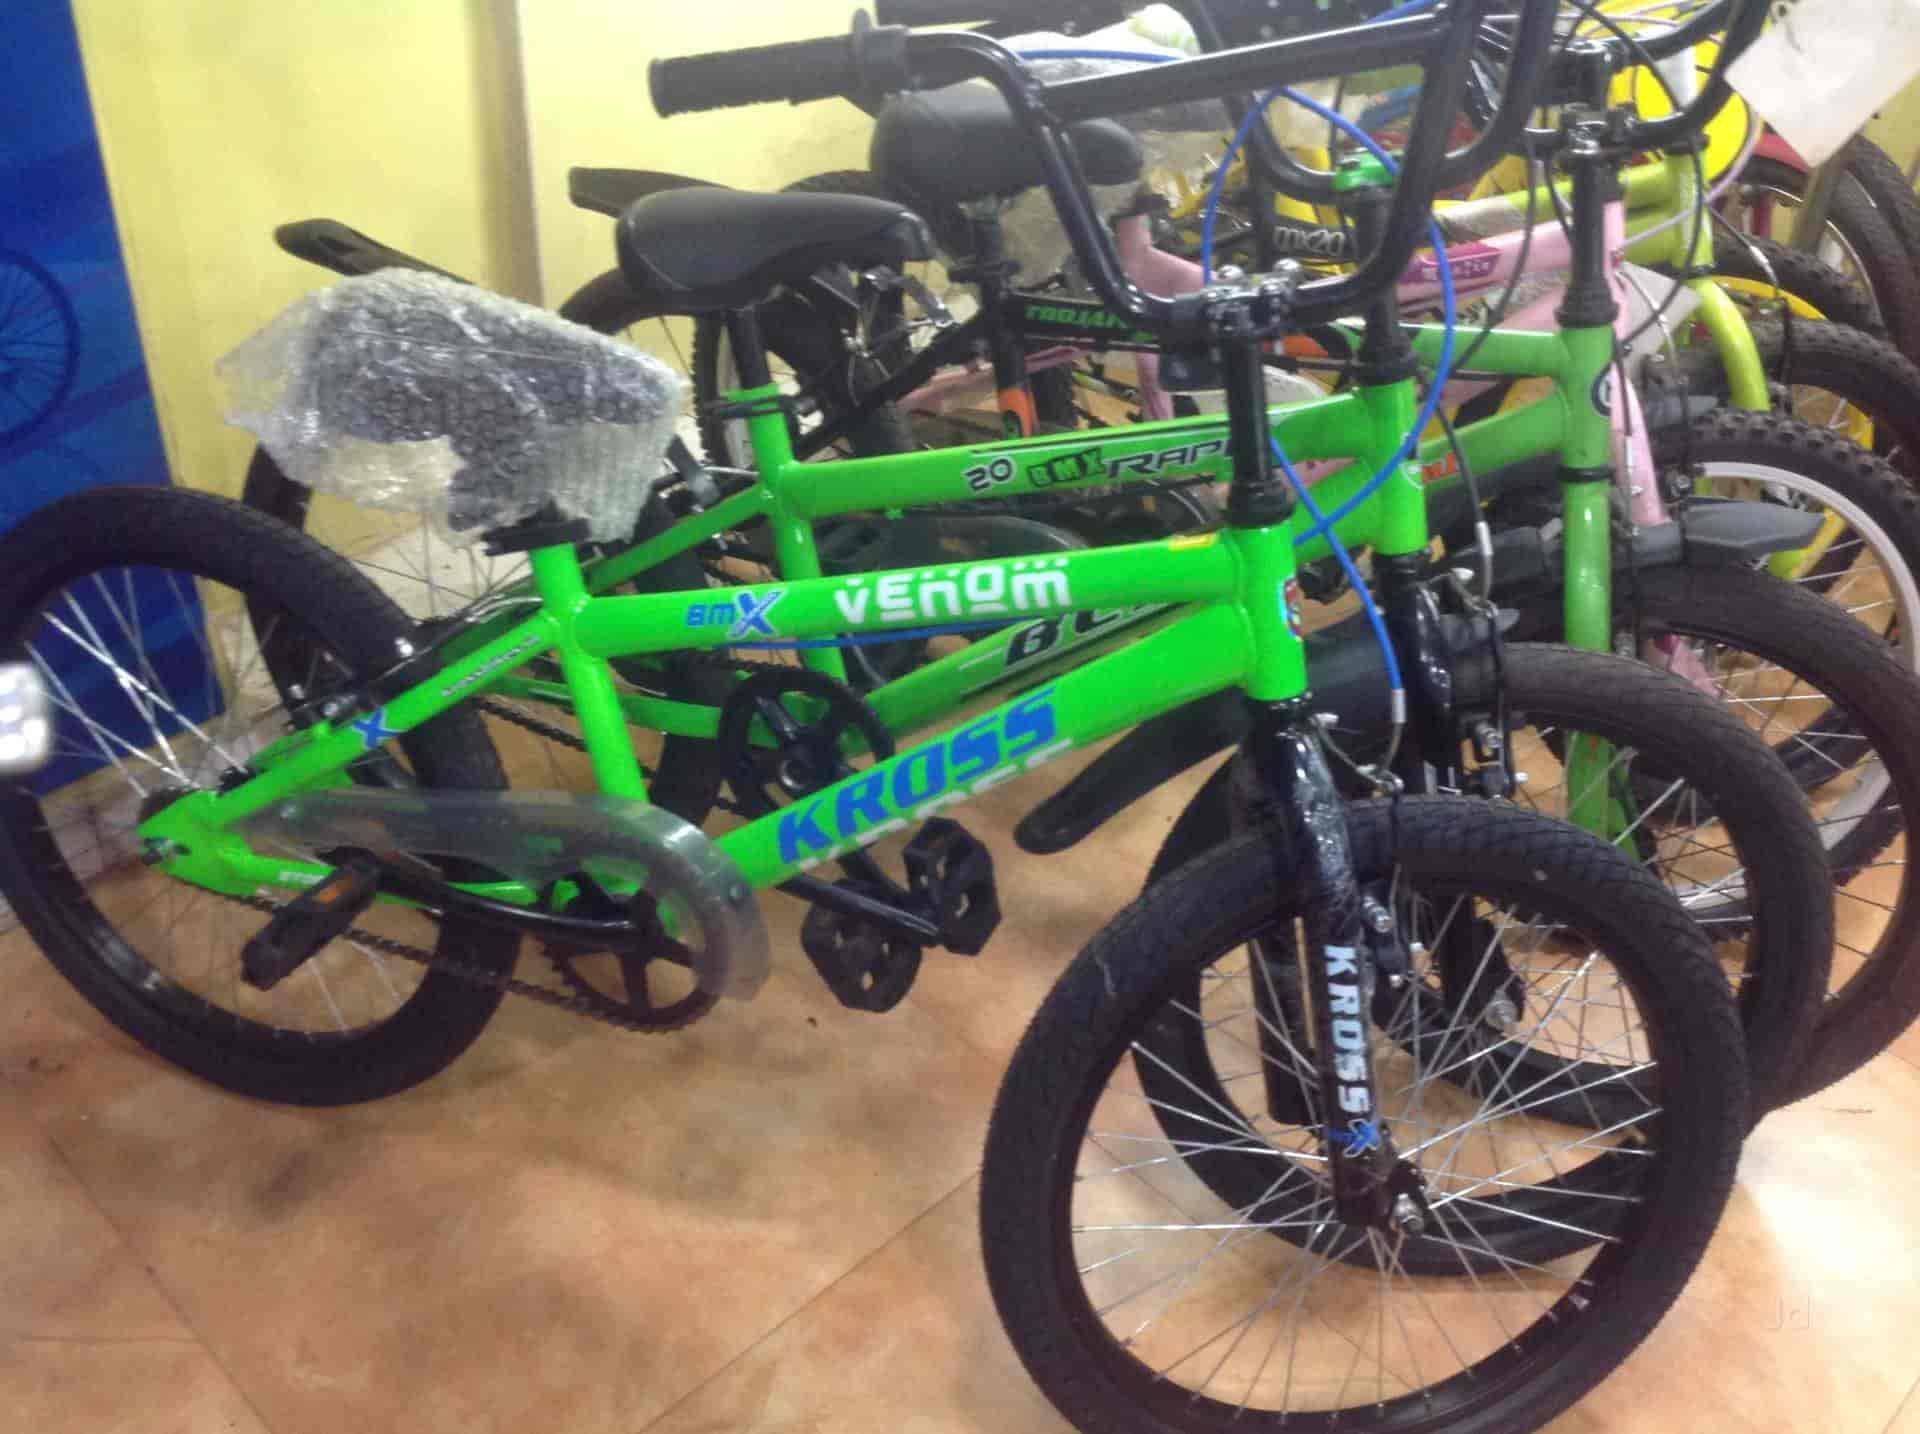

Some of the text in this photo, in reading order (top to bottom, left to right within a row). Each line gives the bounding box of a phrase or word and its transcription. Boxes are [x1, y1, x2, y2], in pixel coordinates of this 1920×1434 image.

[962, 456, 1016, 492] 20
[777, 686, 1058, 865] KROSS
[1324, 944, 1372, 1114] KROSS
